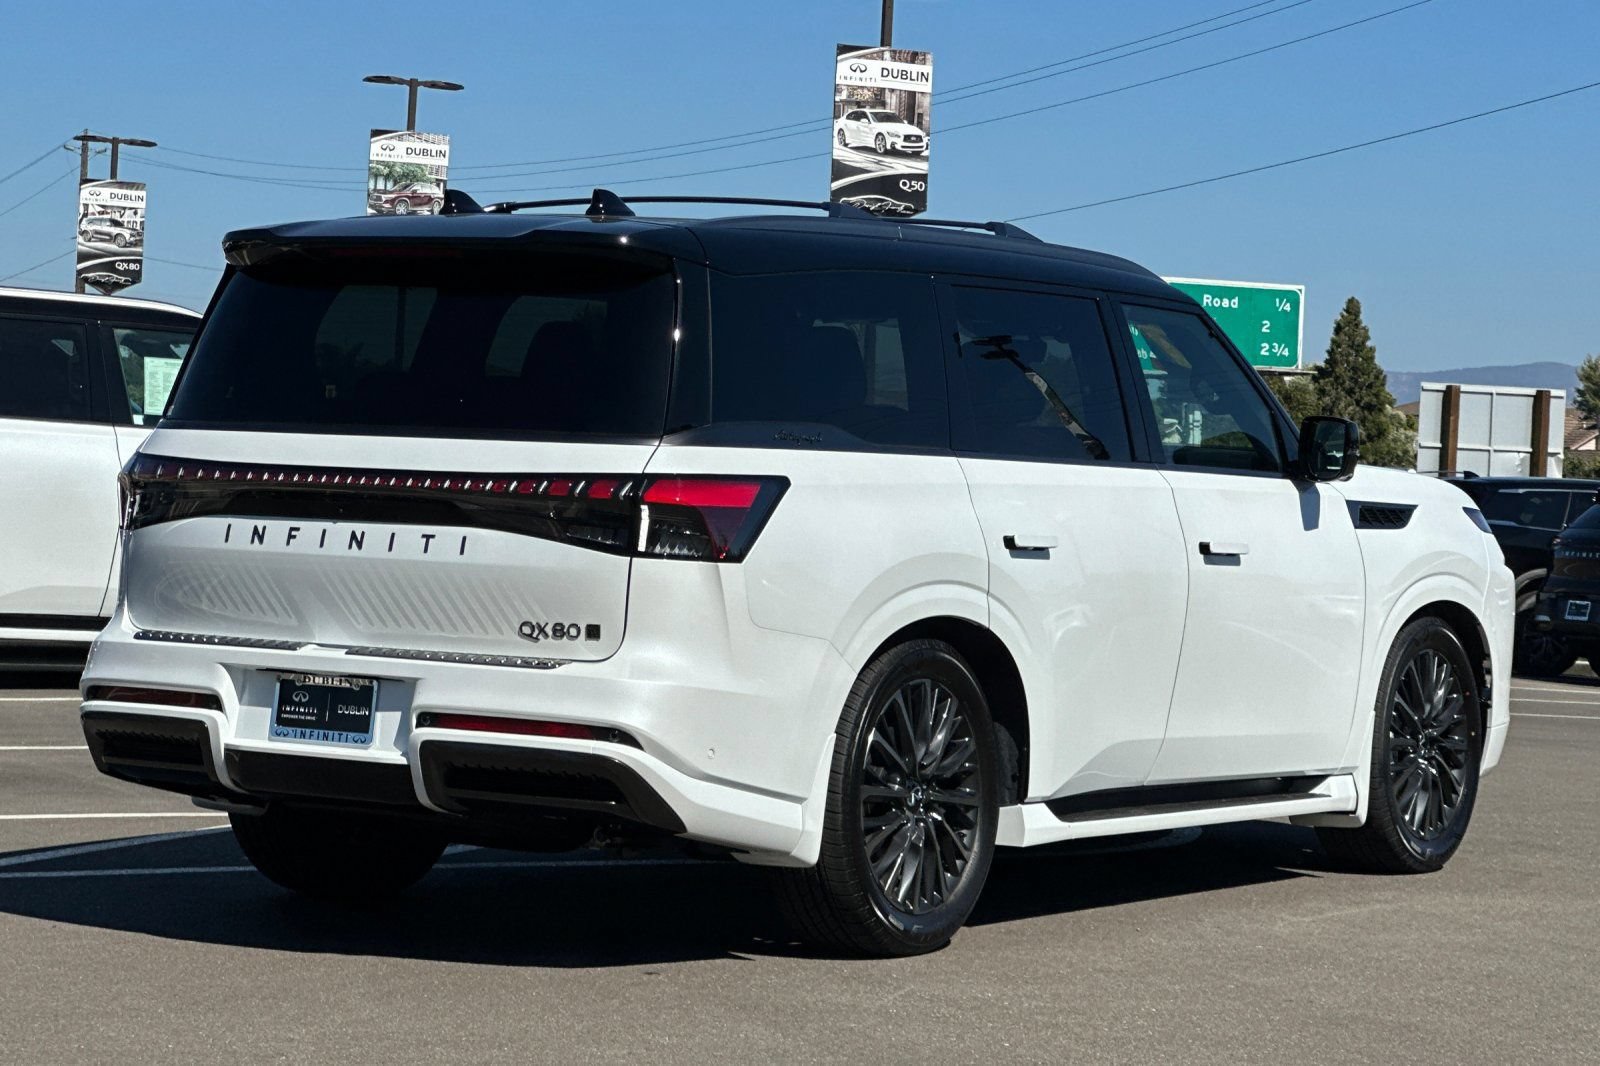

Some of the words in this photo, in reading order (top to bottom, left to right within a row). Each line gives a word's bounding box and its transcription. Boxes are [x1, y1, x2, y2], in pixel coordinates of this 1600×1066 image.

[839, 75, 877, 83] INFINITI
[881, 67, 930, 83] DUBLIN
[405, 147, 447, 158] DUBLIN
[899, 179, 925, 192] Q50
[109, 192, 144, 202] DUBLIN
[115, 261, 140, 271] QX80
[1202, 294, 1239, 309] Road
[1261, 320, 1271, 333] 2
[224, 523, 467, 556] INFINITI
[518, 621, 582, 643] QX80
[282, 704, 317, 714] INFINITI
[337, 704, 369, 716] DUBLIN
[293, 728, 349, 743] INFINITI
